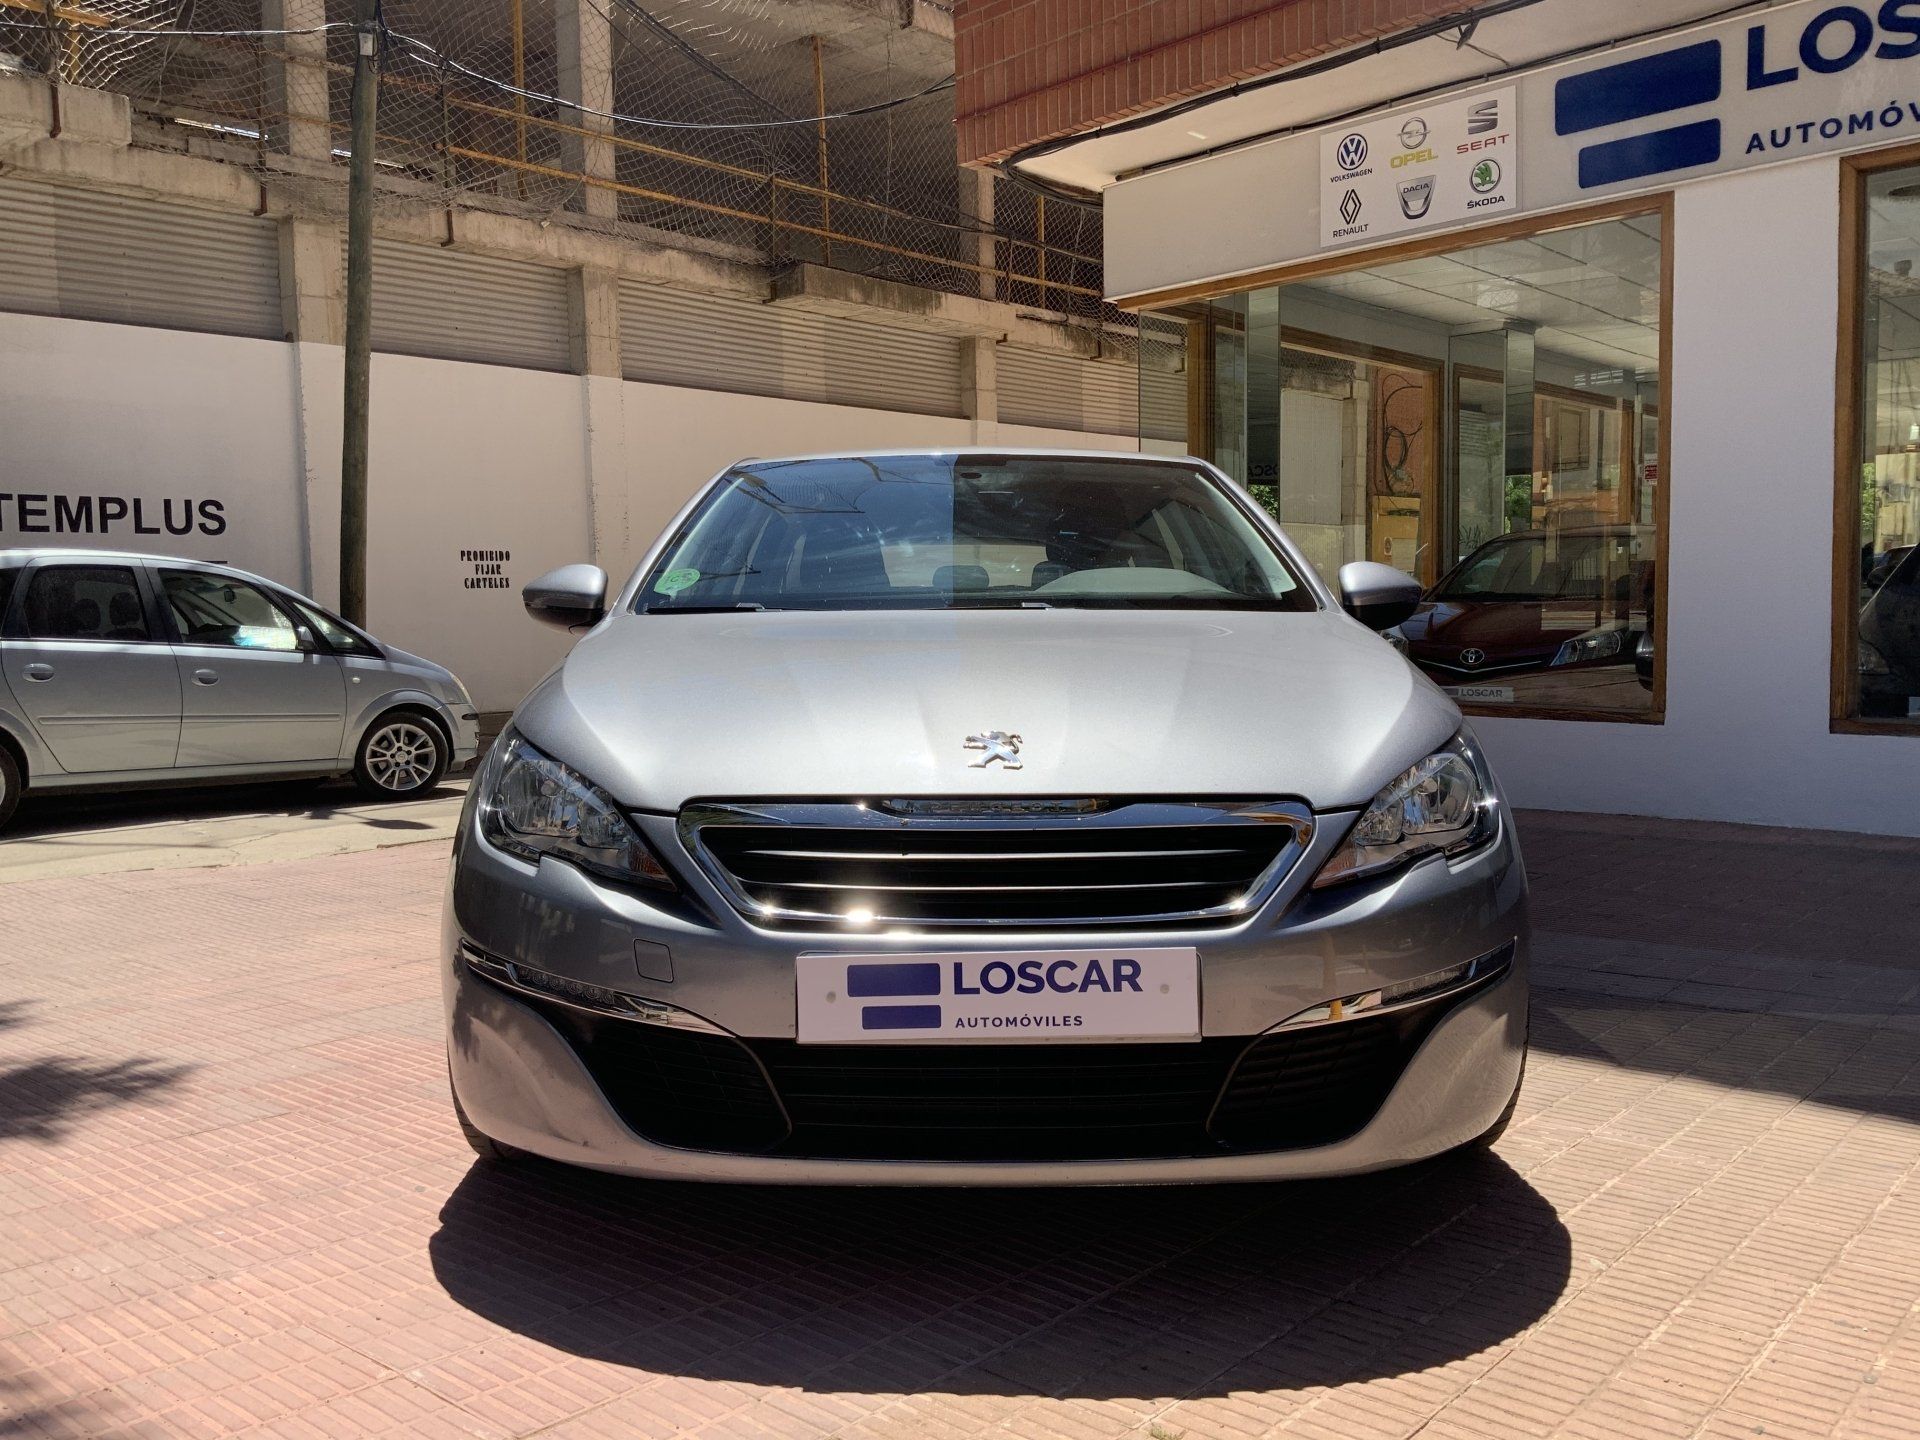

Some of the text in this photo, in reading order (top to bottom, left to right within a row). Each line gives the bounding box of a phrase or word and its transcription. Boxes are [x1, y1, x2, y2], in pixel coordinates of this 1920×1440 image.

[1746, 0, 1920, 91] LOS
[1456, 134, 1509, 155] SEAT
[1390, 148, 1439, 169] OPEL
[1330, 168, 1373, 183] VOLKSWAGEN
[1403, 182, 1430, 194] DACIA
[1467, 195, 1505, 210] ŠKODA
[1333, 224, 1369, 238] RENAULT
[460, 550, 511, 562] PROHIBIDO
[475, 563, 502, 575] FIJAR
[464, 577, 510, 589] CARTELES
[1460, 687, 1503, 698] LOSCAR
[953, 958, 1144, 995] LOSCAR
[955, 1013, 1083, 1029] AUTOMÓVILES
